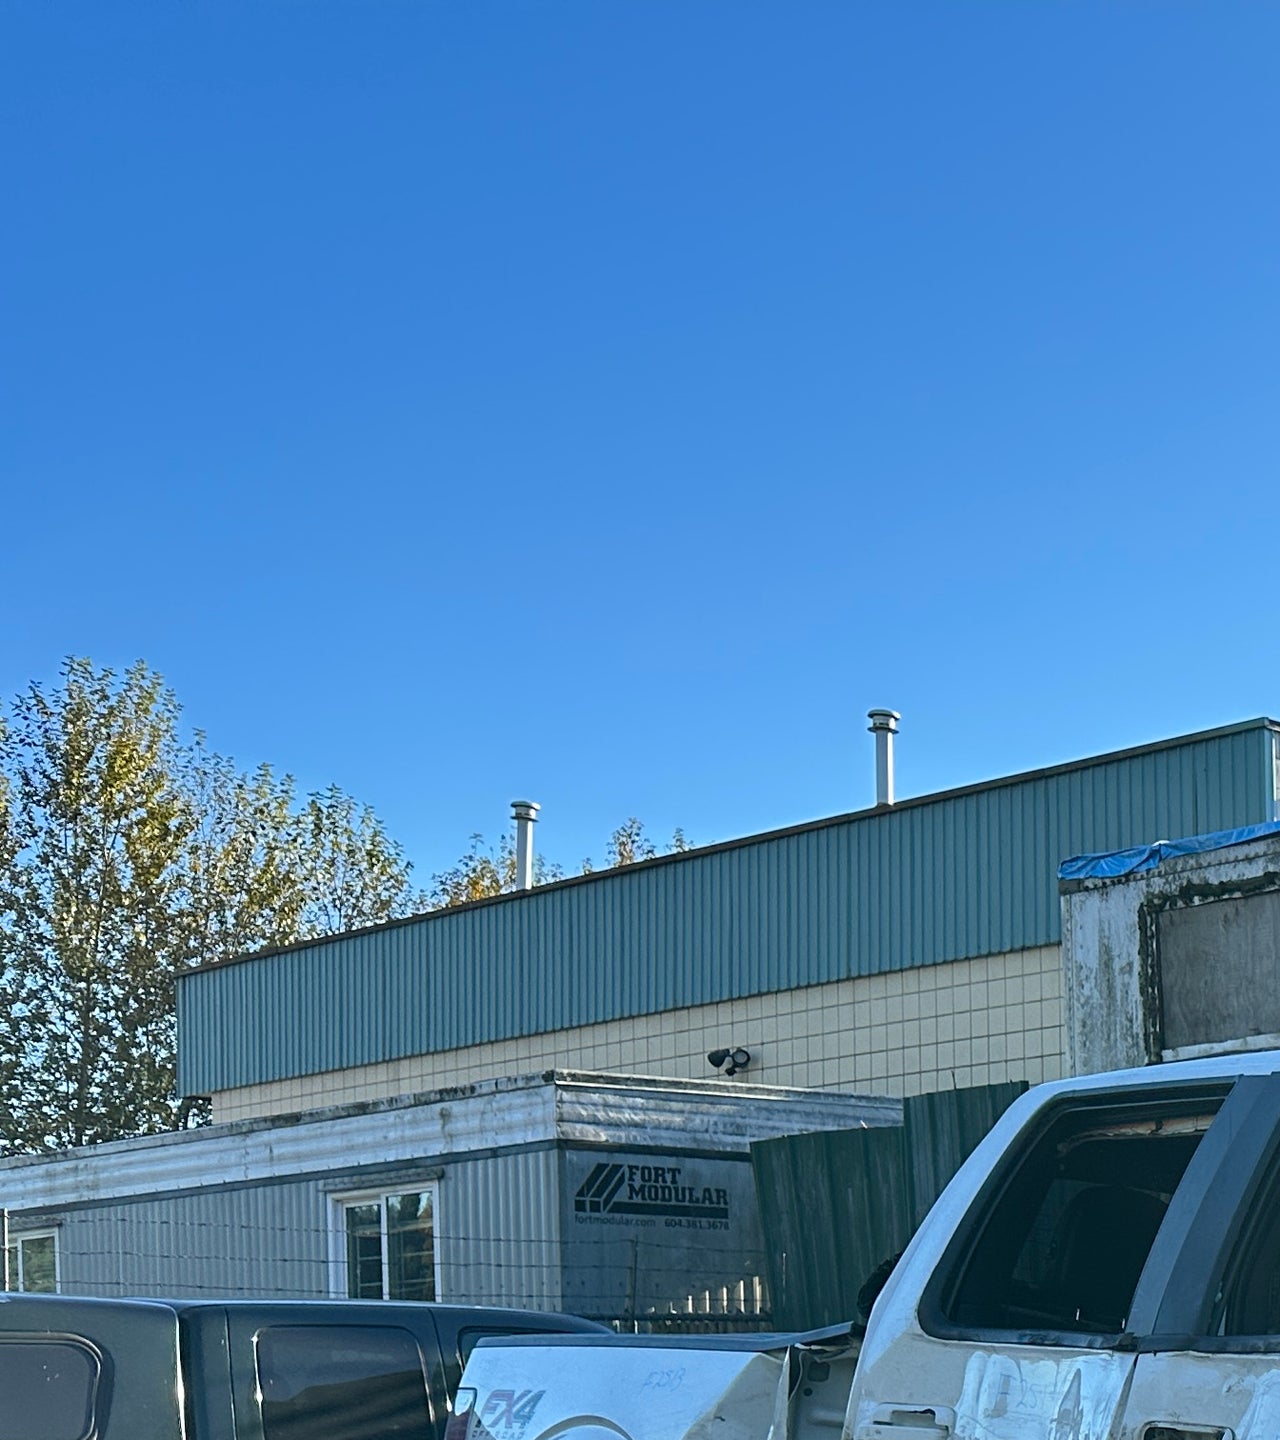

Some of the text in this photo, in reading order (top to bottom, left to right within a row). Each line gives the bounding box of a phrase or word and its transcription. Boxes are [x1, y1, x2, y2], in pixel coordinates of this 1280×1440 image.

[626, 1164, 682, 1185] FORT
[627, 1183, 729, 1206] MODULAR
[574, 1214, 657, 1228] fortmodular.com
[475, 1389, 547, 1430] FX4
